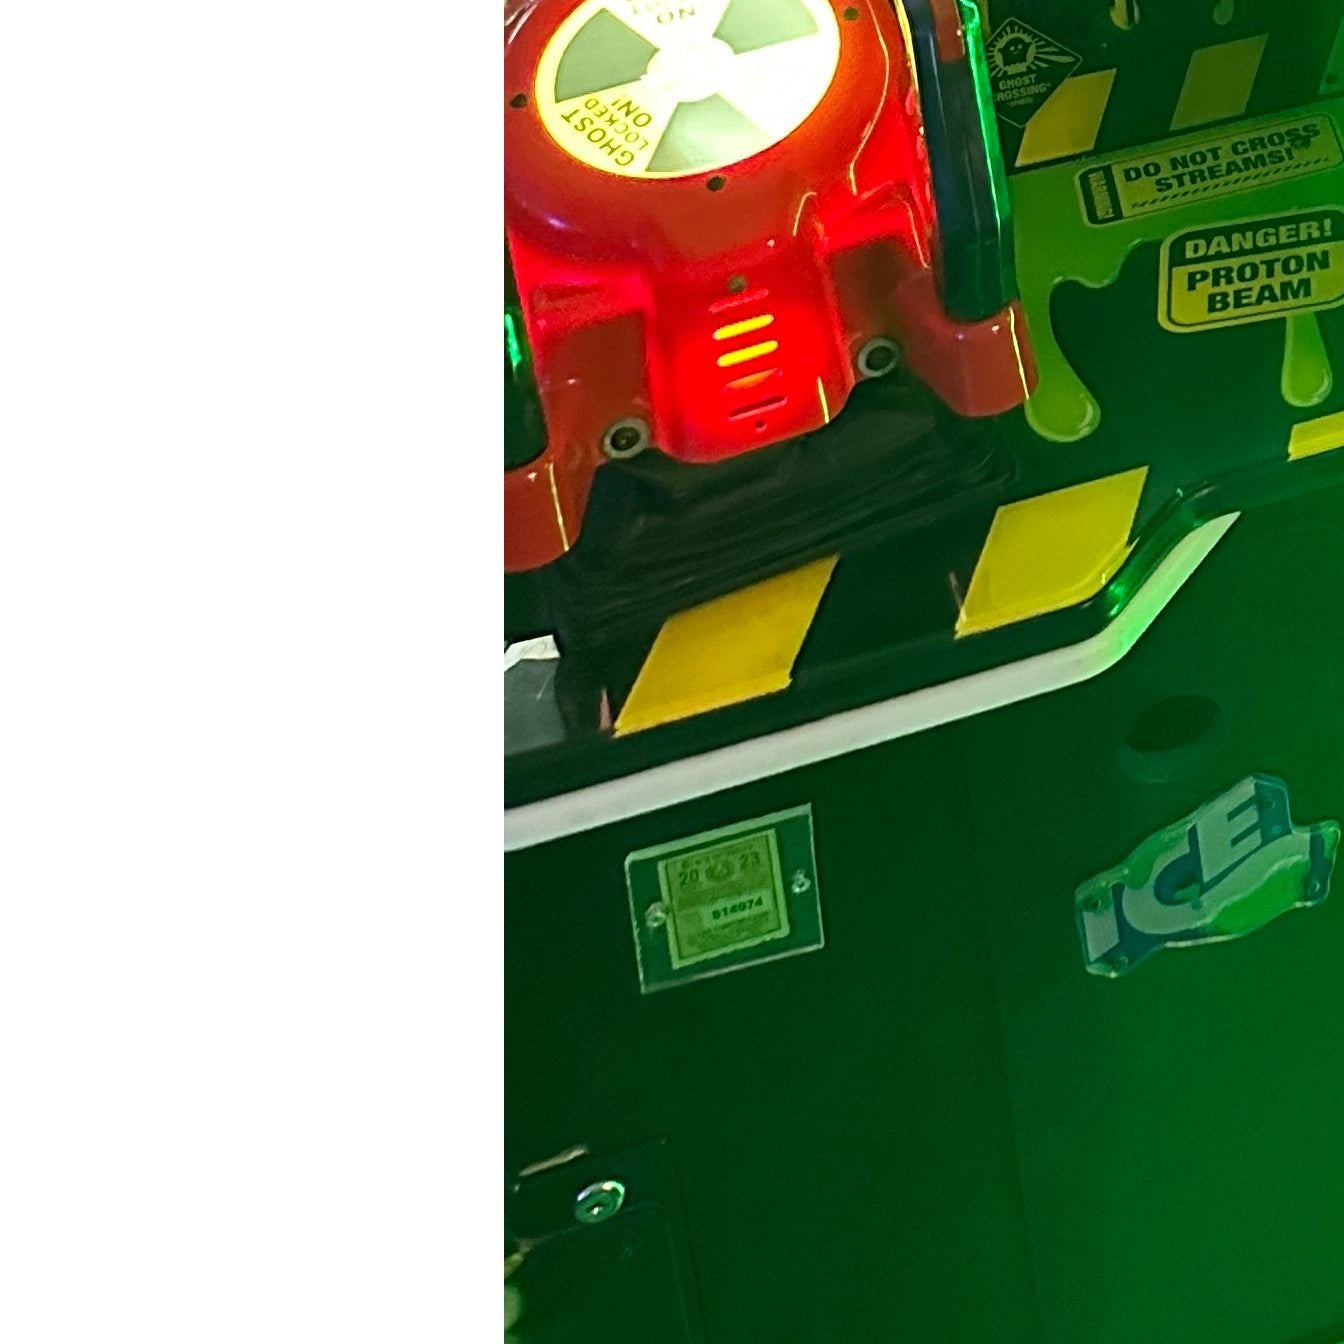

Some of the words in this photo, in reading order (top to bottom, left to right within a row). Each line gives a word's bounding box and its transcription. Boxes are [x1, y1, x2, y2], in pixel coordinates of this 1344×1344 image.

[999, 74, 1037, 91] GHOST
[584, 97, 648, 151] LOCKED
[611, 93, 652, 128] ON!
[562, 108, 635, 166] GHOST
[1123, 162, 1162, 183] DO
[1171, 145, 1222, 172] NOT
[1231, 123, 1321, 150] CROSS
[1155, 148, 1295, 194] STREAMS!
[1184, 217, 1333, 260] DANGER!
[1186, 250, 1330, 292] PROTON
[1207, 277, 1312, 314] BEAM
[678, 868, 699, 889] 20
[1083, 775, 1310, 962] ICE
